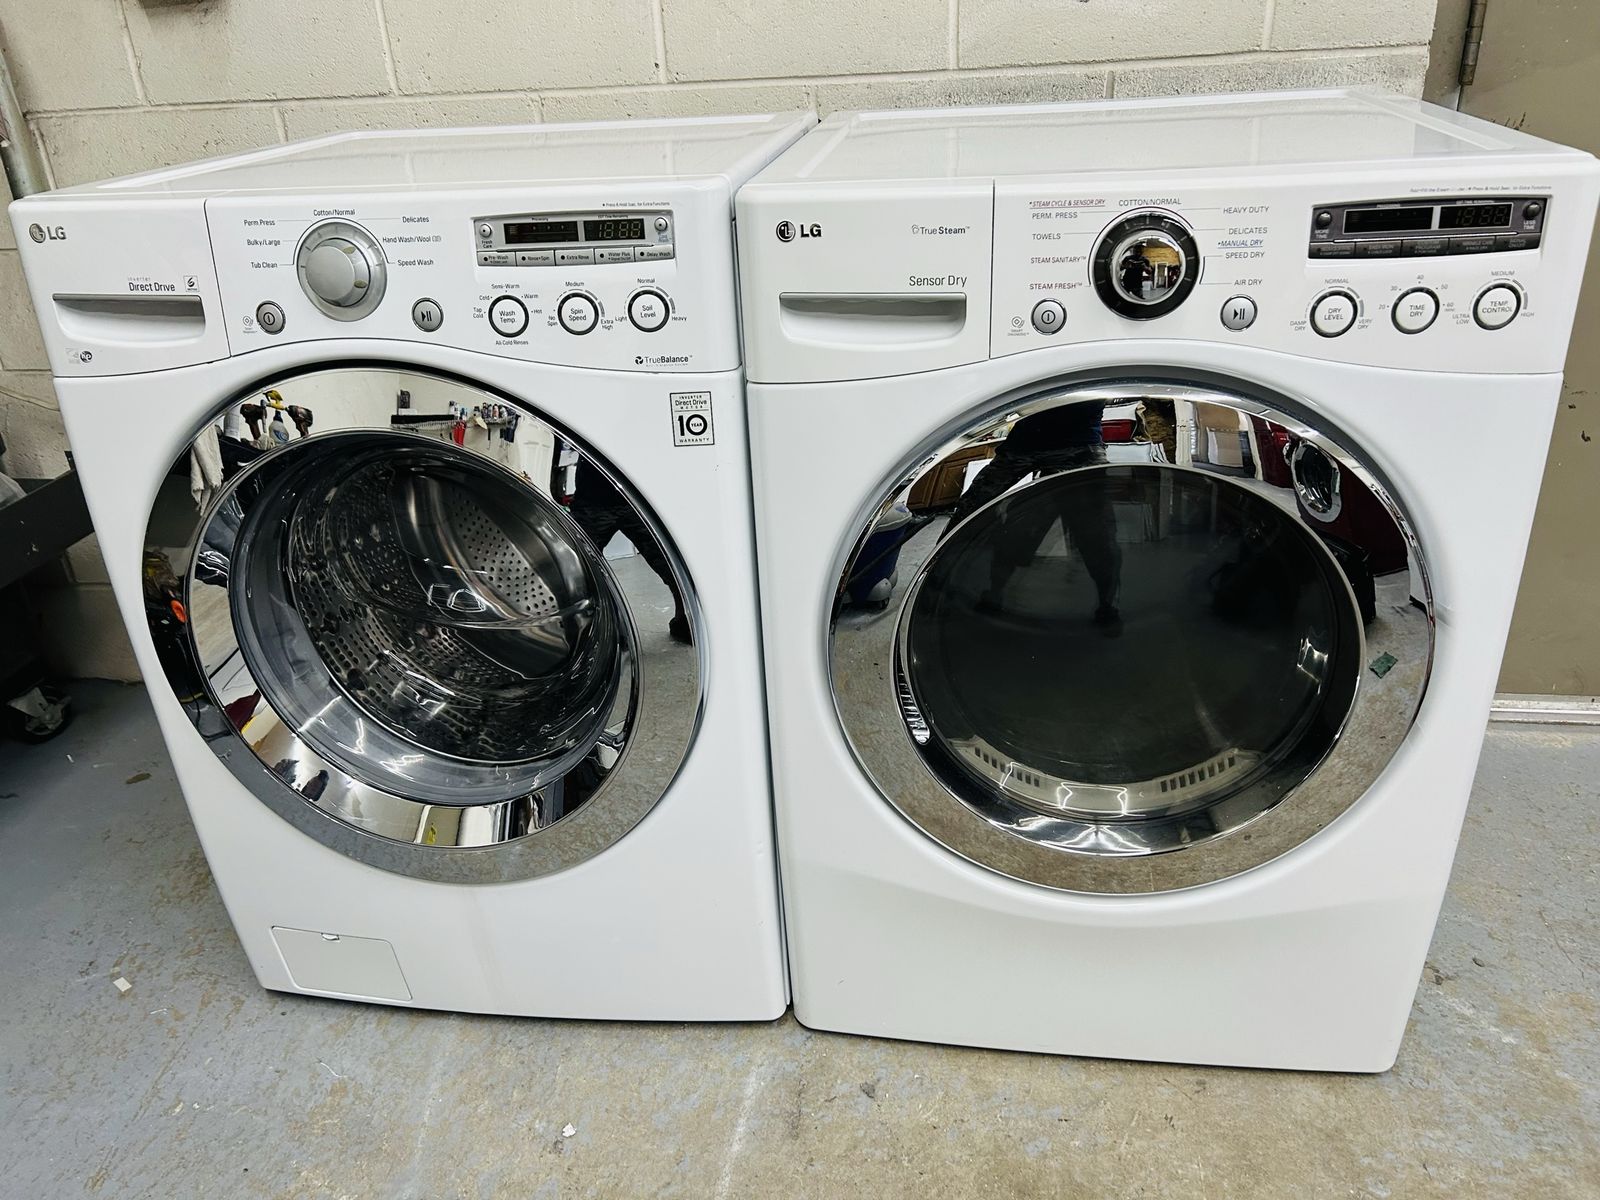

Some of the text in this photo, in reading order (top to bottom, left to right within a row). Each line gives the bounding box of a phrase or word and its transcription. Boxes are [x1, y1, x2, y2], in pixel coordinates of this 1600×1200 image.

[314, 209, 356, 217] Cotton/Normal
[47, 226, 66, 240] LG
[800, 224, 822, 237] LG
[1228, 227, 1267, 235] DELICATES
[398, 259, 416, 267] Speed
[909, 275, 967, 287] Sensor Dry
[129, 282, 152, 291] Direct
[154, 282, 175, 291] Drive
[678, 414, 708, 436] 10
